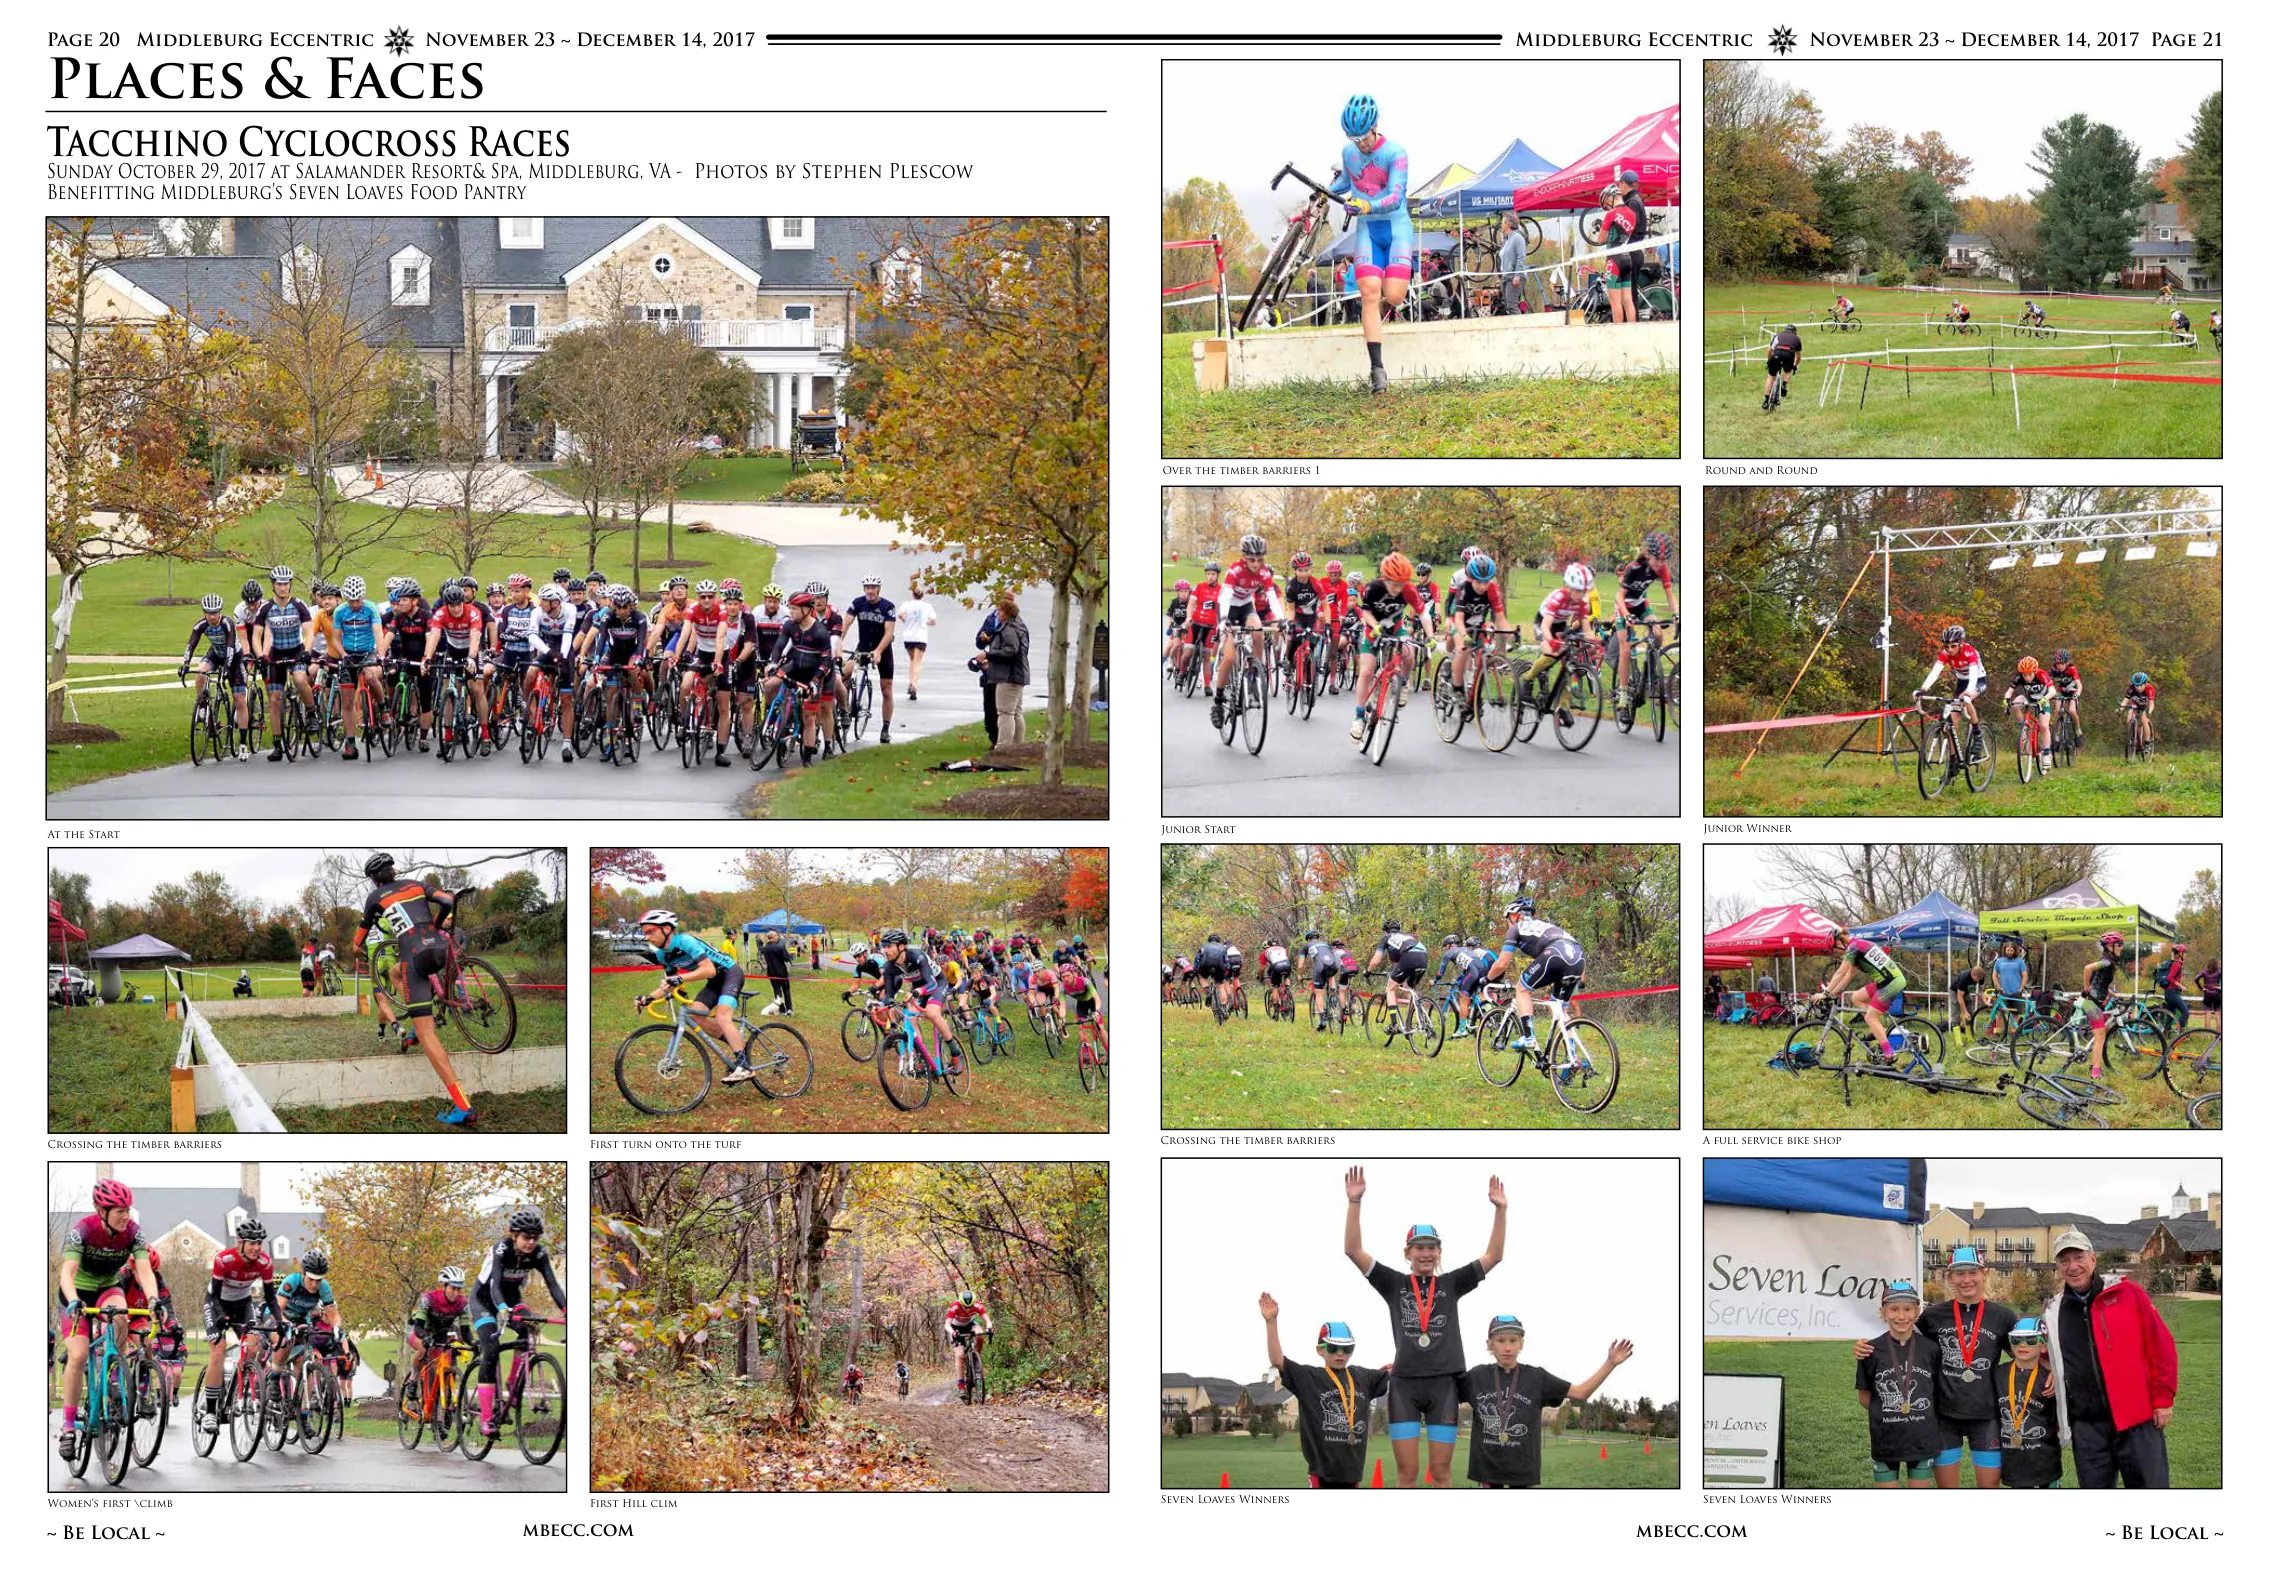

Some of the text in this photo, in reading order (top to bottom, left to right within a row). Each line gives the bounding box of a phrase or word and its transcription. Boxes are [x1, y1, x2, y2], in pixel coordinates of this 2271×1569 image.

[98, 31, 120, 47] 20
[534, 31, 555, 47] 23
[682, 31, 707, 49] 14,
[712, 31, 756, 47] 2017
[1918, 31, 1940, 47] 23
[2066, 31, 2091, 49] 14,
[2096, 31, 2140, 47] 2017
[2202, 31, 2222, 47] 21
[200, 162, 223, 180] 29,
[228, 162, 266, 179] 2017
[1316, 465, 1320, 475] 1
[386, 906, 409, 933] 745
[2095, 912, 2124, 923] Shop
[1707, 1254, 1808, 1295] Seven
[1707, 1299, 1841, 1329] Services, Inc.
[1722, 1417, 1768, 1431] Loaves
[522, 1523, 634, 1537] MBECC.COM
[1636, 1524, 1748, 1538] MBECC.COM
